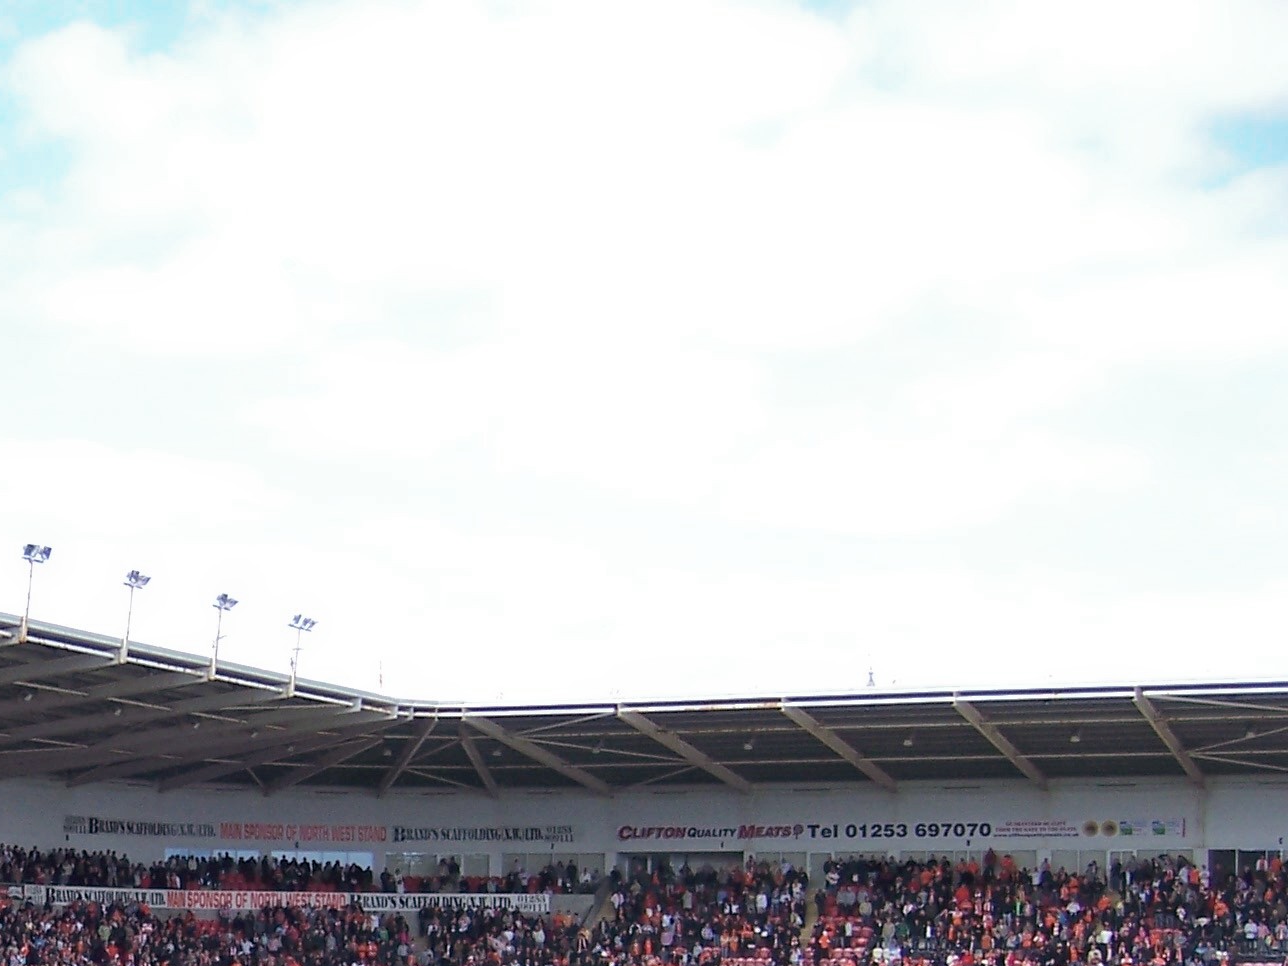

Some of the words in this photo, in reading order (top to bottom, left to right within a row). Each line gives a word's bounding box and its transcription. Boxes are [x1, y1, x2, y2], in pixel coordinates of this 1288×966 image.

[220, 822, 241, 839] MAIN
[244, 823, 284, 840] SPONSOR
[286, 824, 298, 840] OF
[300, 824, 329, 841] NORTH
[332, 825, 355, 841] WEST
[358, 825, 387, 842] STAND
[394, 826, 439, 841] BRAND'S
[440, 827, 501, 841] SCAFFOLDING
[618, 825, 687, 840] CLIFTON
[687, 827, 737, 838] QUALITY
[737, 825, 792, 839] MEATS
[807, 824, 838, 838] Tel
[845, 823, 908, 838] 01253
[914, 823, 991, 838] 697070
[167, 891, 185, 907] MAIN
[187, 891, 233, 908] SPONSOR
[236, 892, 248, 908] OF
[251, 892, 283, 908] NORTH
[286, 893, 312, 908] WEST
[314, 893, 347, 909] STAND
